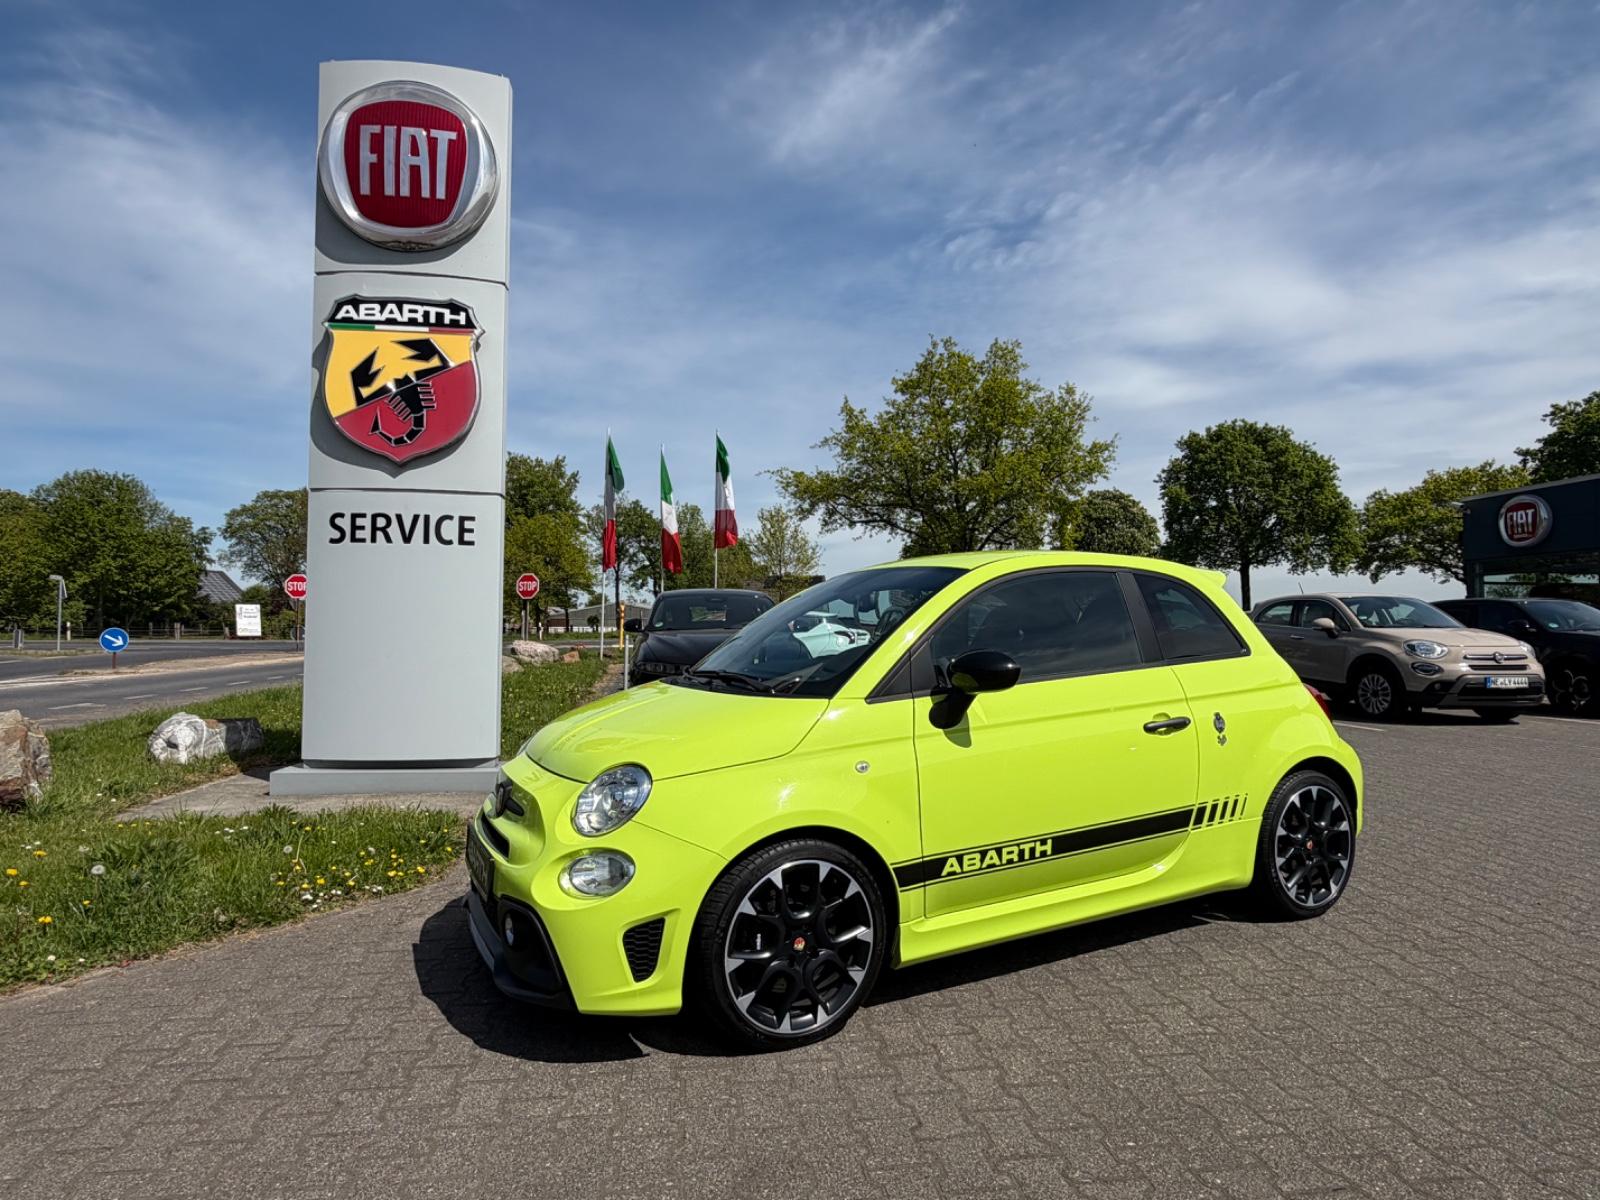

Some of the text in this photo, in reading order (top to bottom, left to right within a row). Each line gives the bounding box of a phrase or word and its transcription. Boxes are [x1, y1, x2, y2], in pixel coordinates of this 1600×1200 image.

[359, 124, 458, 201] FIAT
[335, 303, 466, 325] ABARTH
[328, 512, 476, 546] SERVICE
[1506, 509, 1535, 535] FIAT
[519, 581, 537, 591] STOP
[941, 838, 1053, 877] ABARTH
